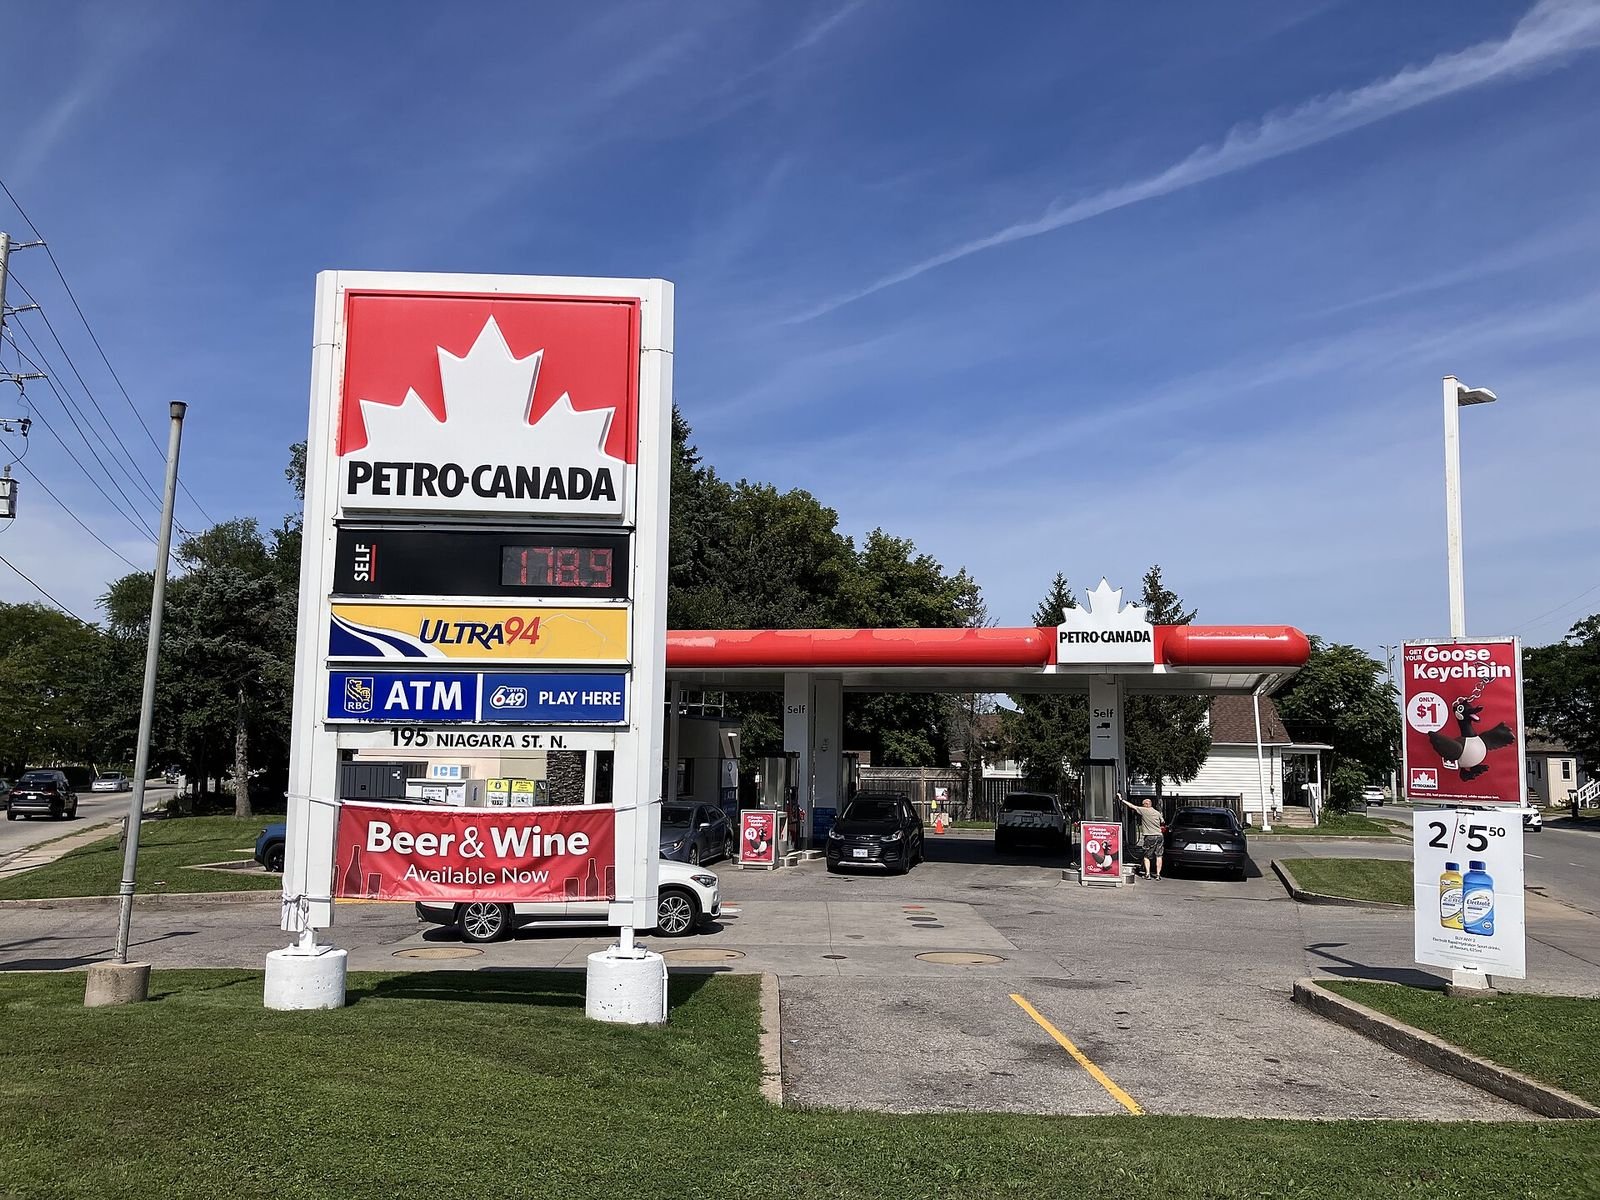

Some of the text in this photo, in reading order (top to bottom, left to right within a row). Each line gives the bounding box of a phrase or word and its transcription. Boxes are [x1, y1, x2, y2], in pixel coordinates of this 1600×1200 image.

[353, 543, 370, 582] SELF
[1423, 646, 1491, 662] Goose
[1413, 662, 1511, 682] Keychain
[384, 680, 462, 711] ATM
[538, 691, 621, 705] PLAY HERE
[347, 702, 370, 710] RBC
[787, 704, 806, 715] Self
[1093, 708, 1115, 719] Self
[390, 727, 567, 749] 195 NIAGARA ST. N.
[433, 766, 459, 776] ICE
[366, 820, 590, 859] Beer & Wine
[403, 864, 549, 885] Available Now
